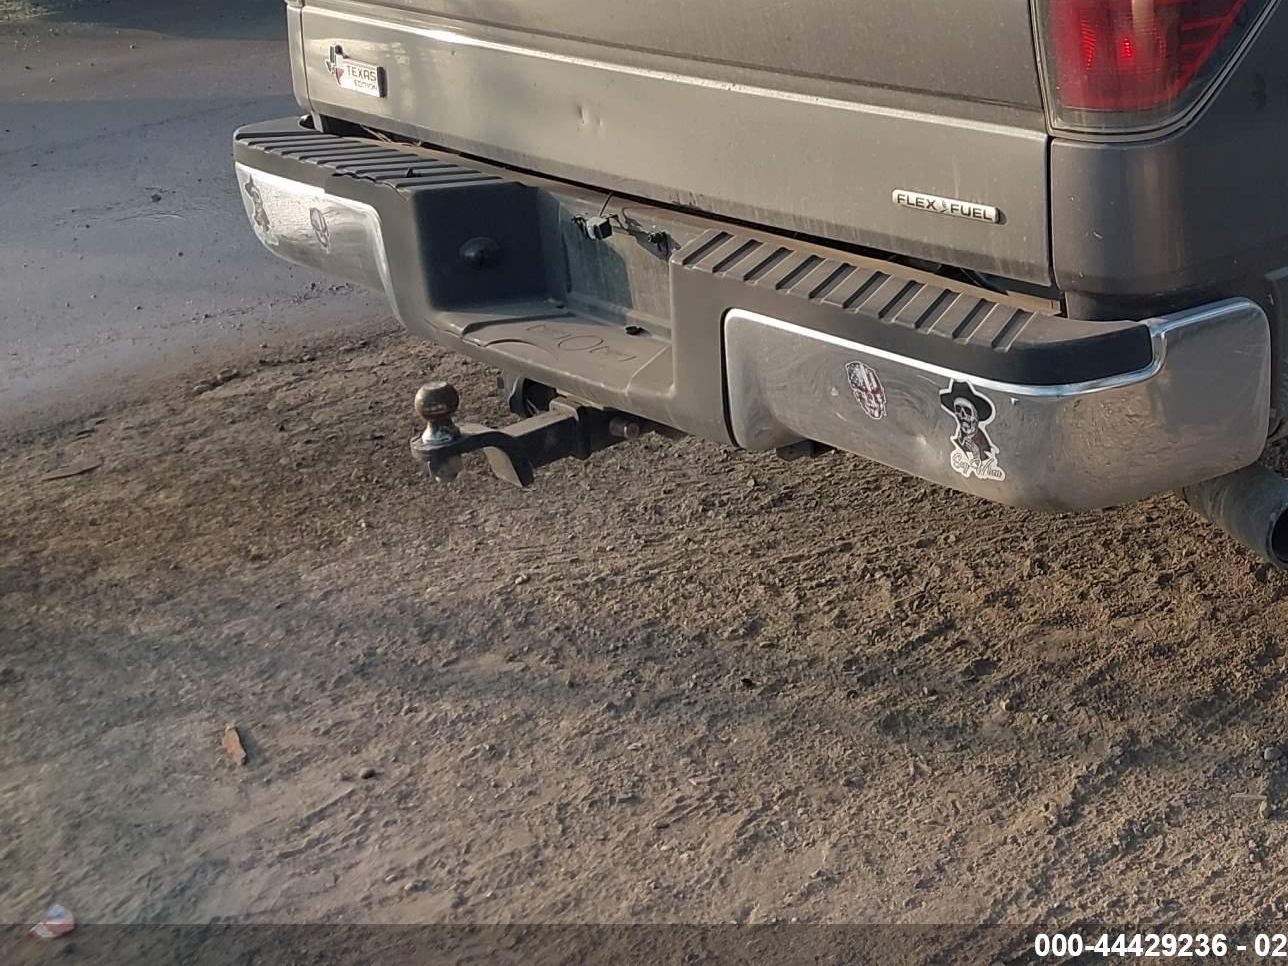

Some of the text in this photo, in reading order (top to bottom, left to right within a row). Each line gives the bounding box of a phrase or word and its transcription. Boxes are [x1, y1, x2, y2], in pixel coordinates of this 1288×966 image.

[346, 65, 377, 82] TEXAS
[896, 192, 993, 221] FLEX FUEL
